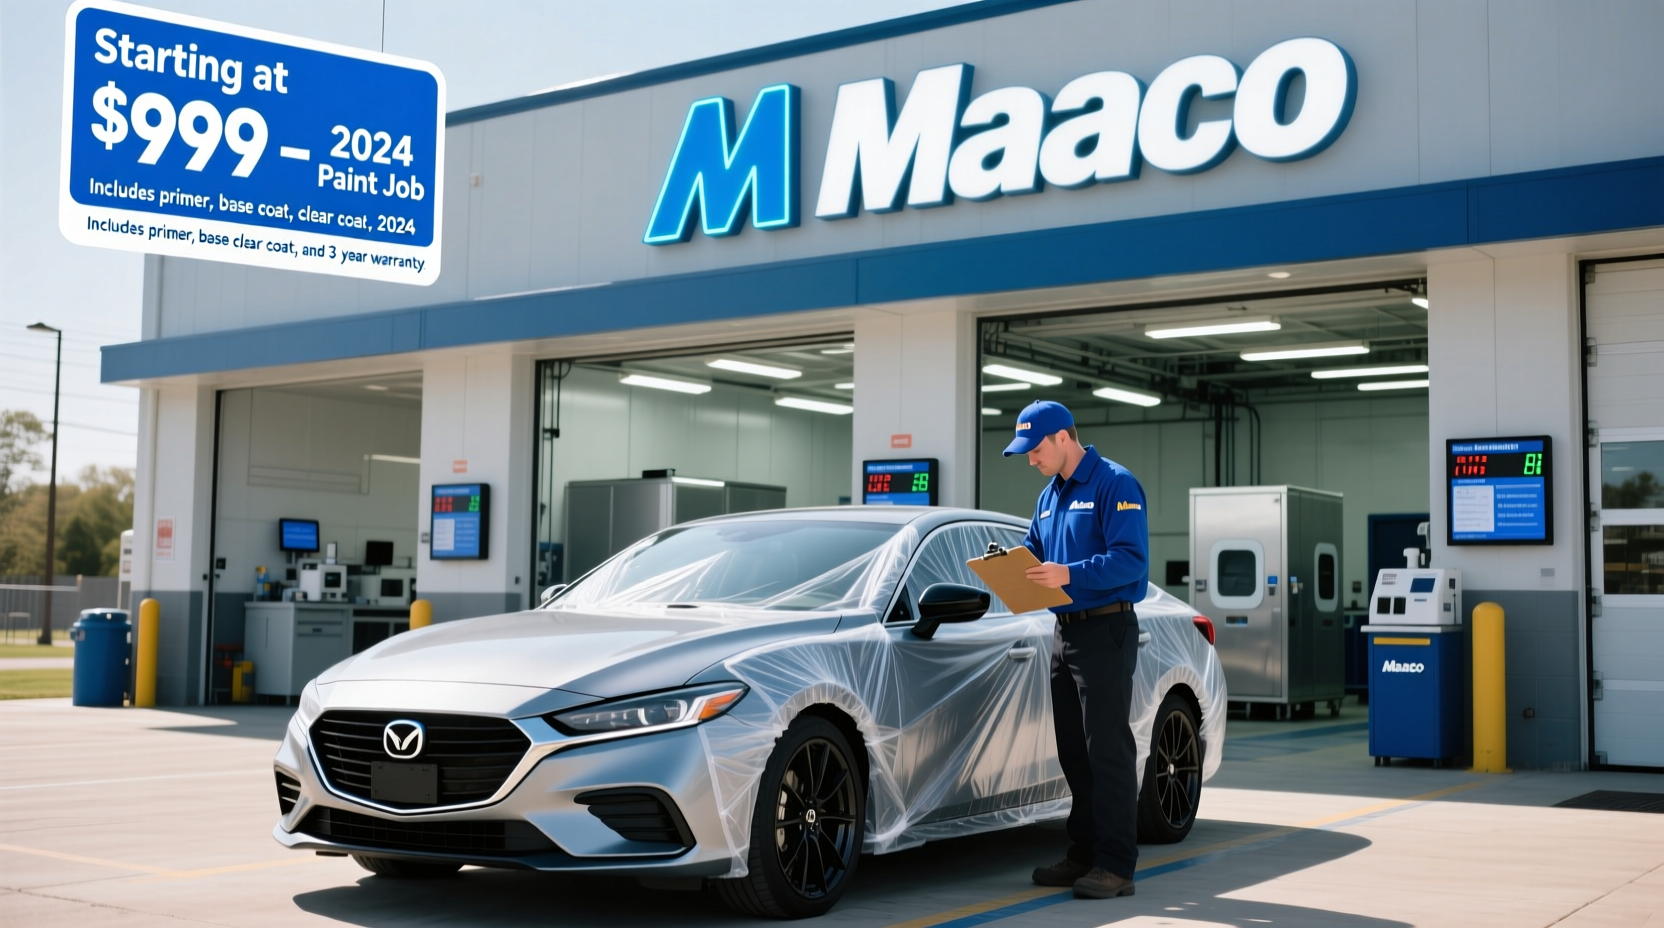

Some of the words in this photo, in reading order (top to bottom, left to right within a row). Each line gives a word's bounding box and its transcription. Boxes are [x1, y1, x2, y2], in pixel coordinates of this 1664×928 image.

[94, 28, 243, 95] Starting
[252, 62, 289, 94] at
[91, 80, 269, 178] $999
[330, 125, 414, 167] 2024
[643, 83, 798, 244] M
[815, 37, 1356, 219] Maaco
[89, 178, 155, 202] Includes
[159, 188, 214, 212] primer,
[219, 193, 254, 214] base
[257, 203, 294, 223] coat,
[298, 205, 335, 225] clear
[337, 213, 373, 233] coat,
[377, 214, 416, 236] 2024
[318, 163, 378, 195] Paint
[382, 173, 425, 201] Job
[87, 216, 145, 236] Includes
[148, 224, 195, 245] primer,
[199, 228, 230, 246] base
[232, 233, 264, 250] clear
[266, 239, 298, 258] coat,
[302, 245, 326, 258] and
[328, 245, 337, 259] 3
[341, 250, 368, 265] year
[1382, 660, 1424, 673] Maaco
